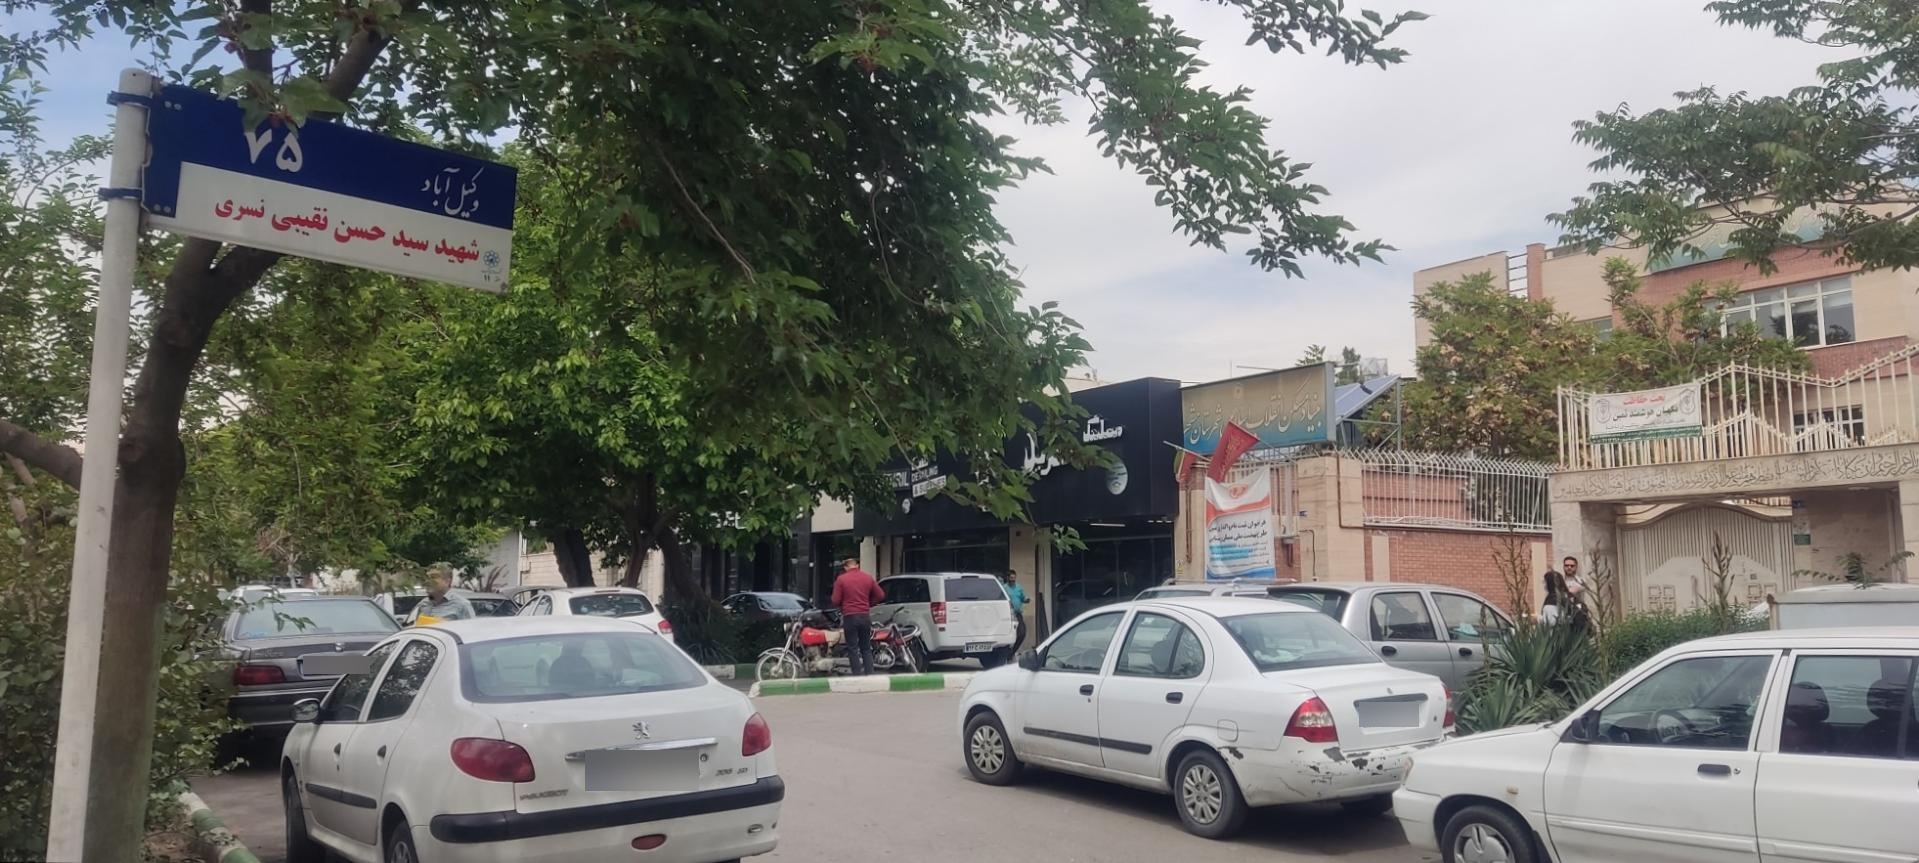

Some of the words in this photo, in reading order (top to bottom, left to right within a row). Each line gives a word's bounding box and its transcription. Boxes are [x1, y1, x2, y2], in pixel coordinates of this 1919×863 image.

[244, 129, 303, 172] ۷۵
[214, 199, 265, 220] نسری
[270, 206, 329, 236] نقیبی
[333, 219, 386, 244] حسن
[392, 229, 430, 259] سید
[434, 239, 480, 264] شهید
